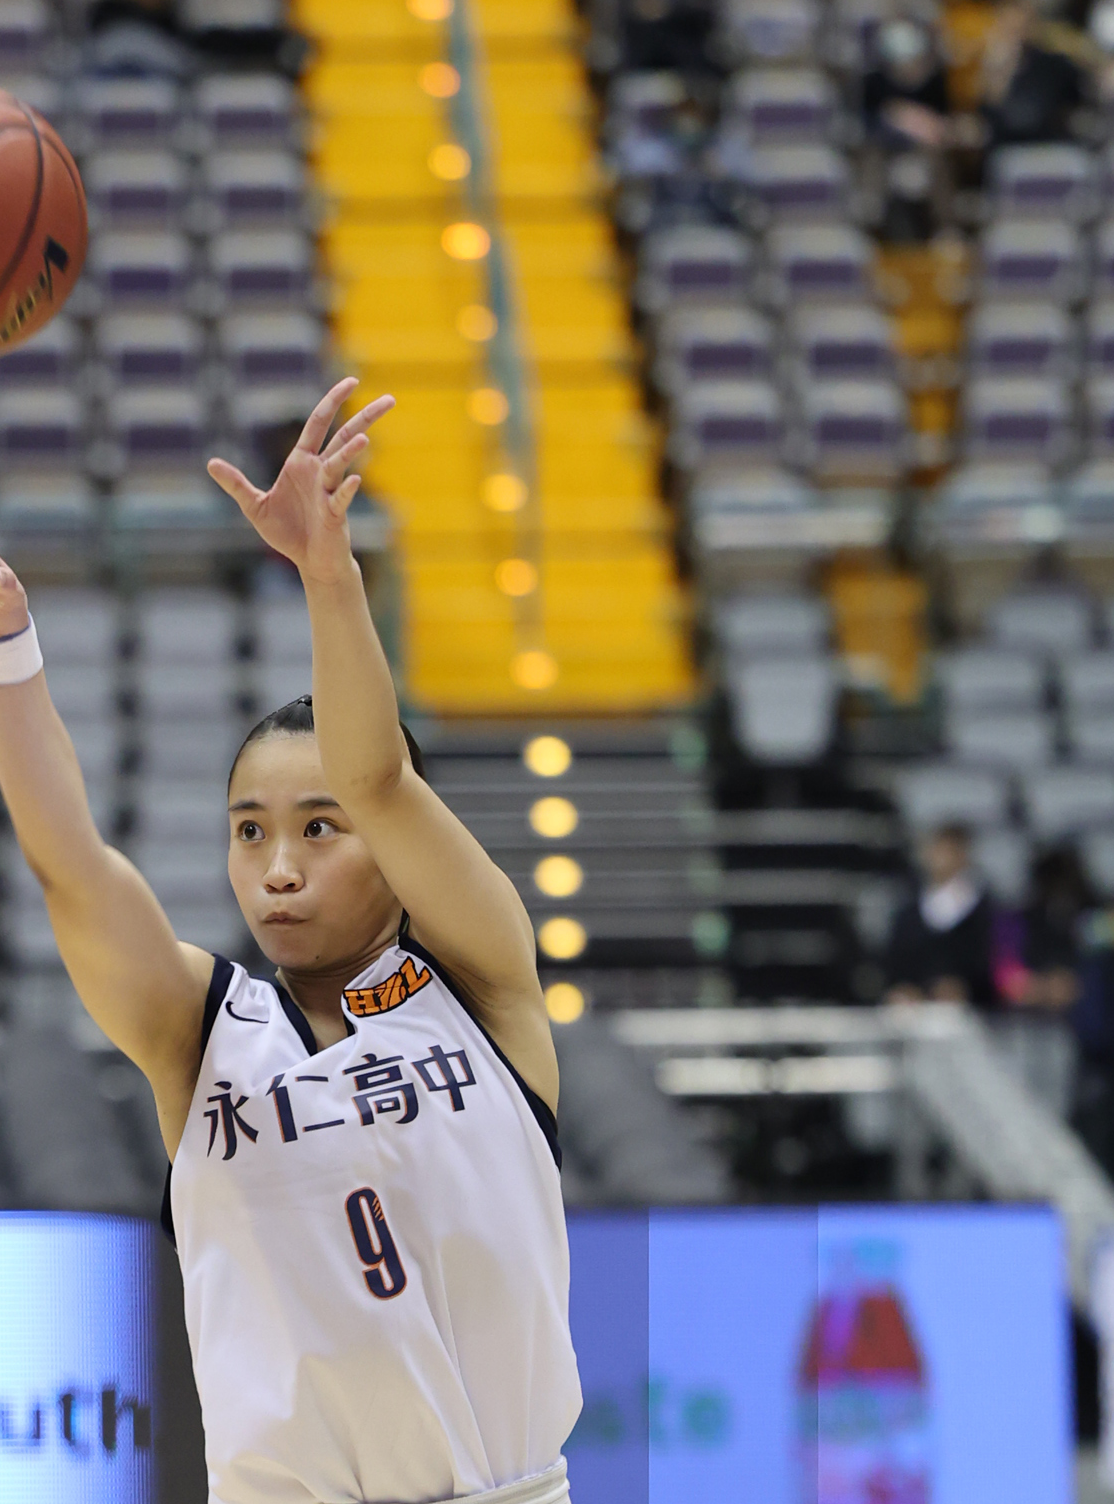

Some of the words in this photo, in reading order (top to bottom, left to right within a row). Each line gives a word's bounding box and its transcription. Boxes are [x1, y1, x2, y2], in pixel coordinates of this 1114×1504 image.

[203, 1044, 477, 1161] 永仁高中
[345, 1186, 408, 1301] 9
